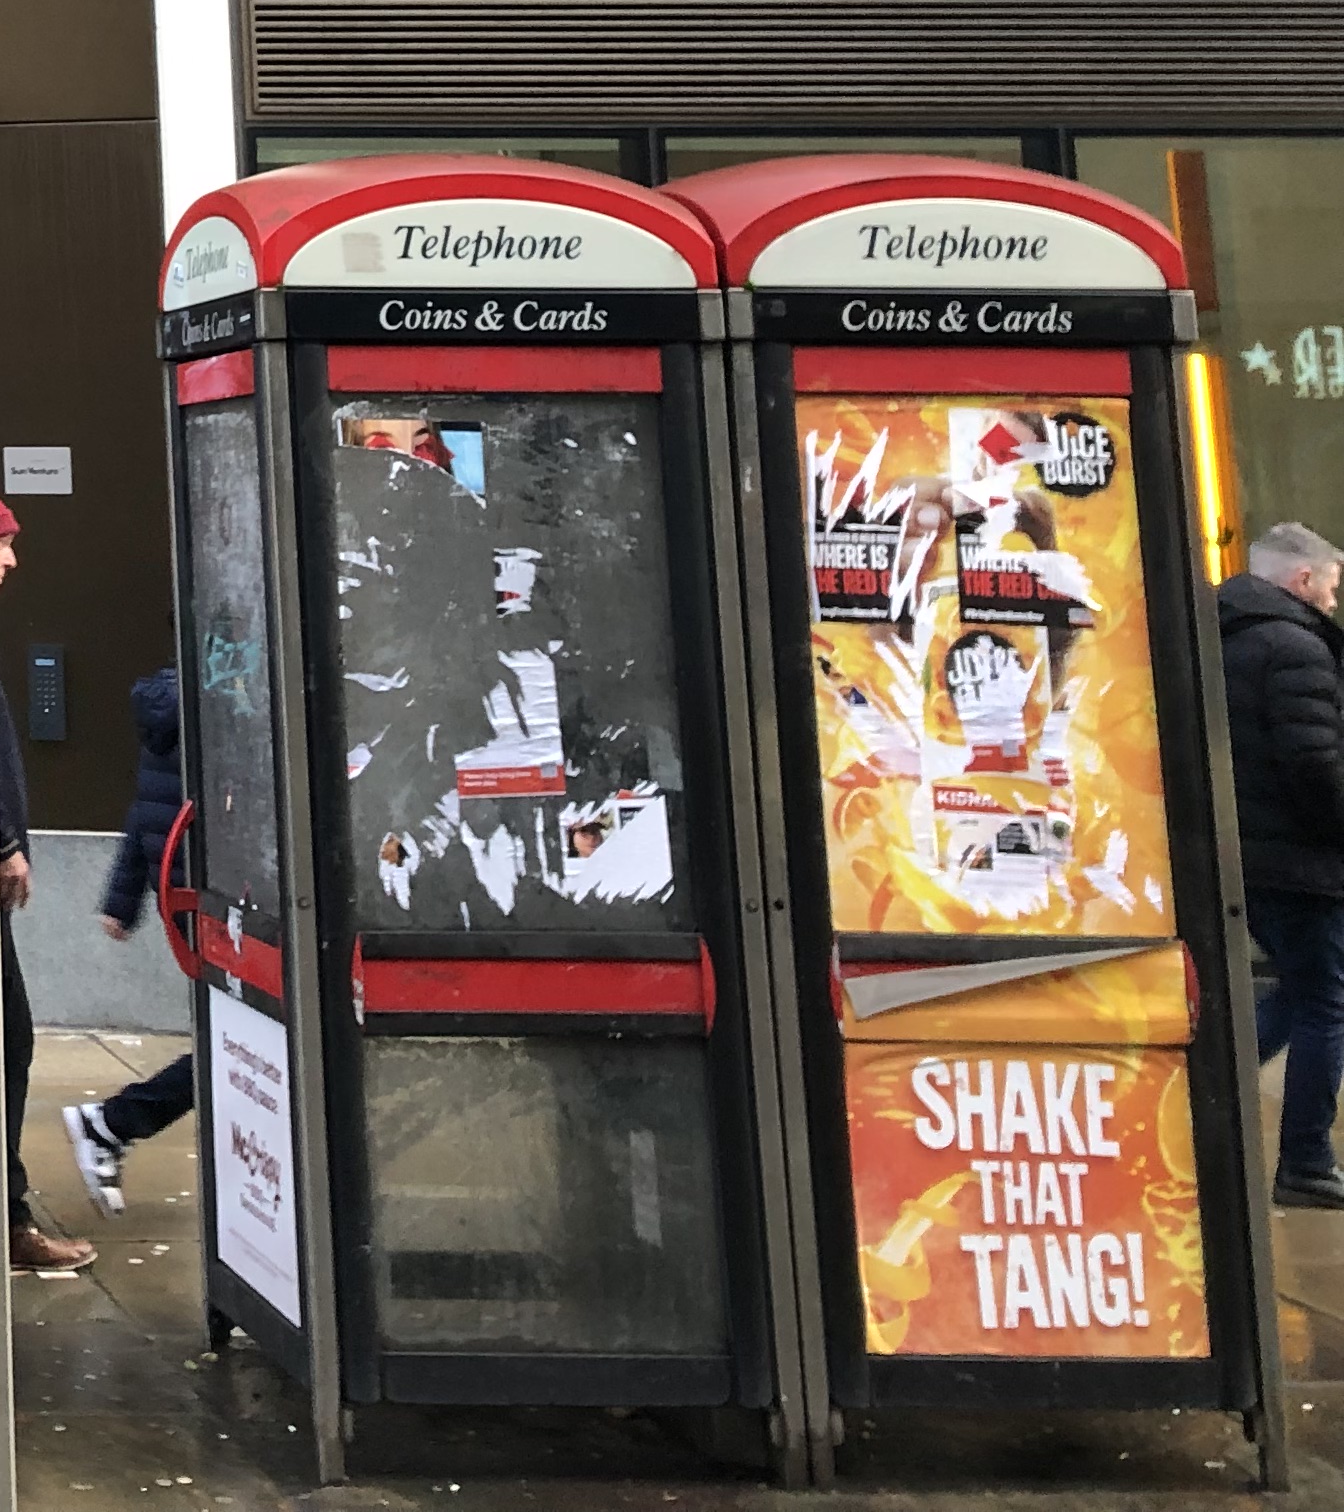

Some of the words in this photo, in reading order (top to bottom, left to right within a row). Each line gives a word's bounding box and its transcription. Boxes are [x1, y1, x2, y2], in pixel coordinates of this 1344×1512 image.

[394, 225, 582, 267] Telephone
[859, 224, 1049, 268] Telephone
[379, 300, 468, 331] Coins
[474, 300, 505, 331] &
[513, 300, 608, 331] Cards
[841, 299, 931, 332] Coins
[938, 300, 969, 333] &
[977, 301, 1073, 334] Cards
[1043, 457, 1108, 486] BURST
[816, 568, 838, 594] HE
[842, 569, 877, 595] RED
[963, 571, 994, 597] THE
[998, 572, 1034, 598] RED
[912, 1057, 1121, 1157] SHAKE
[970, 1159, 1089, 1227] THAT
[960, 1232, 1150, 1330] TANG!
